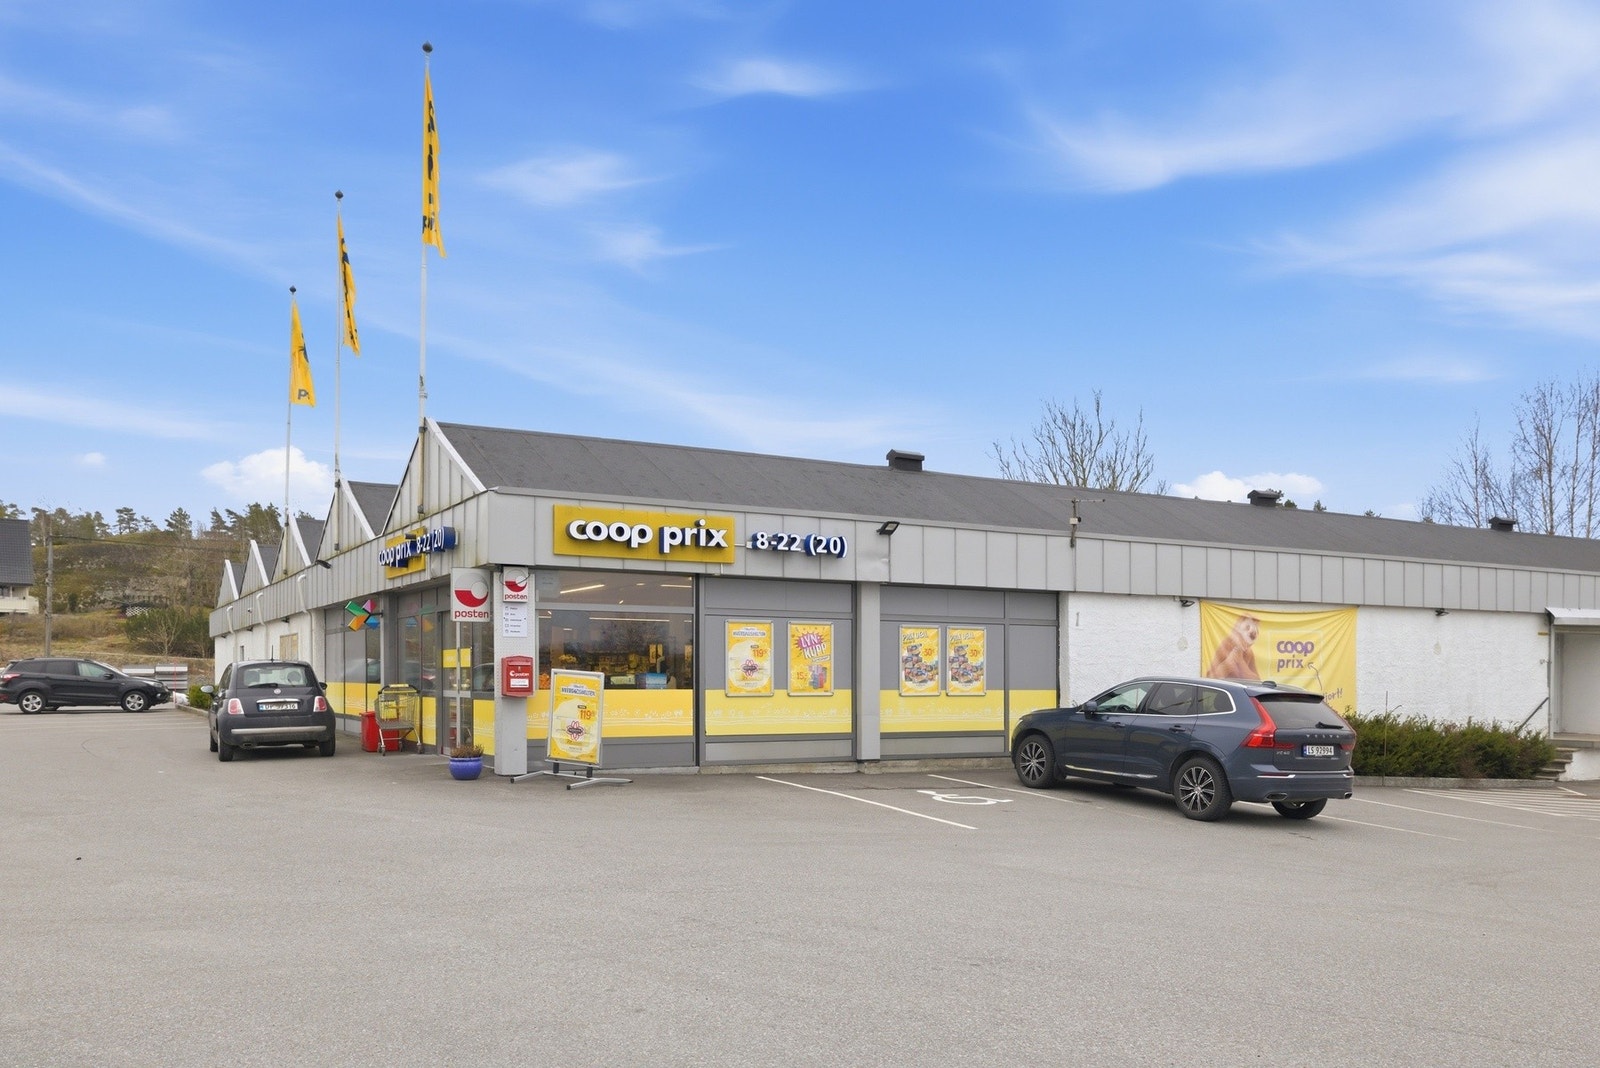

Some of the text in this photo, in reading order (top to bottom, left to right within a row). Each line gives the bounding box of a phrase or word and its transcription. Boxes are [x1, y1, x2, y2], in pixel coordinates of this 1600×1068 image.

[568, 519, 728, 554] coop prix
[378, 526, 445, 567] coop prix 8-22 (20)
[754, 532, 848, 559] 8-22 (20)
[504, 593, 528, 601] posten
[454, 609, 489, 620] posten
[803, 643, 827, 659] KUPP
[1276, 640, 1315, 657] coop
[1277, 654, 1304, 673] prix
[1322, 687, 1344, 702] jort!
[1307, 746, 1314, 754] LS
